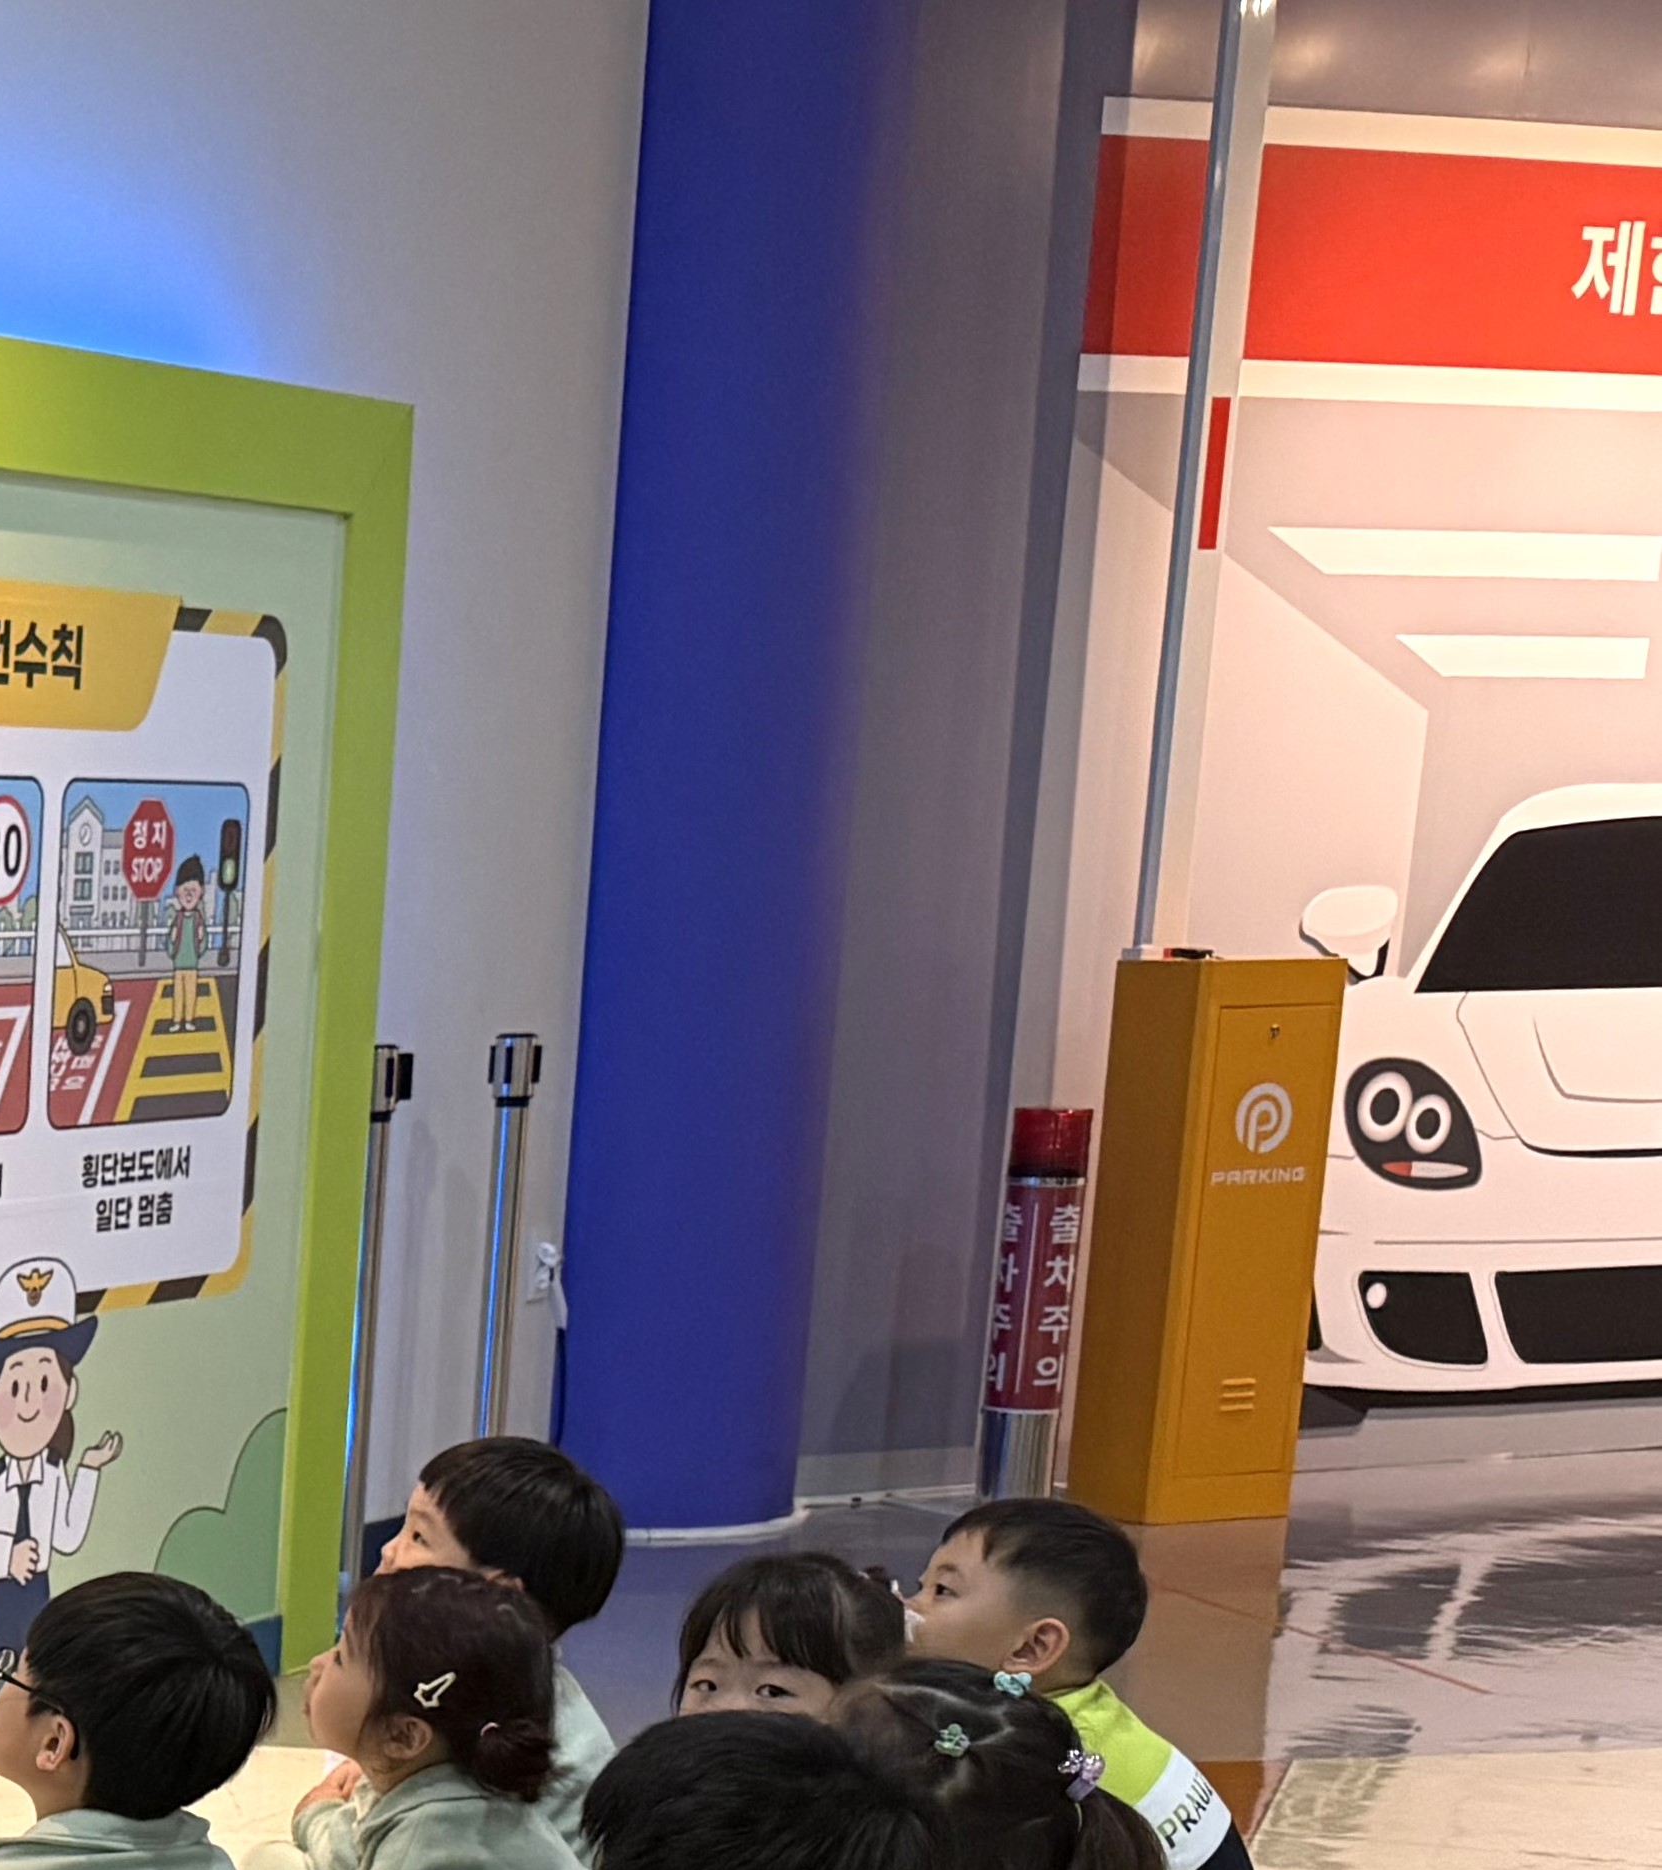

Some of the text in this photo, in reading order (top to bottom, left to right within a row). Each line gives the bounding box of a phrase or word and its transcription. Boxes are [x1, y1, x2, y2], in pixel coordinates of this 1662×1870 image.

[131, 856, 164, 884] STOP
[80, 1146, 191, 1189] 횡단보도에서
[1210, 1166, 1306, 1186] PARKING
[95, 1192, 174, 1231] 일단 멈춤
[1032, 1203, 1081, 1394] 출차주의
